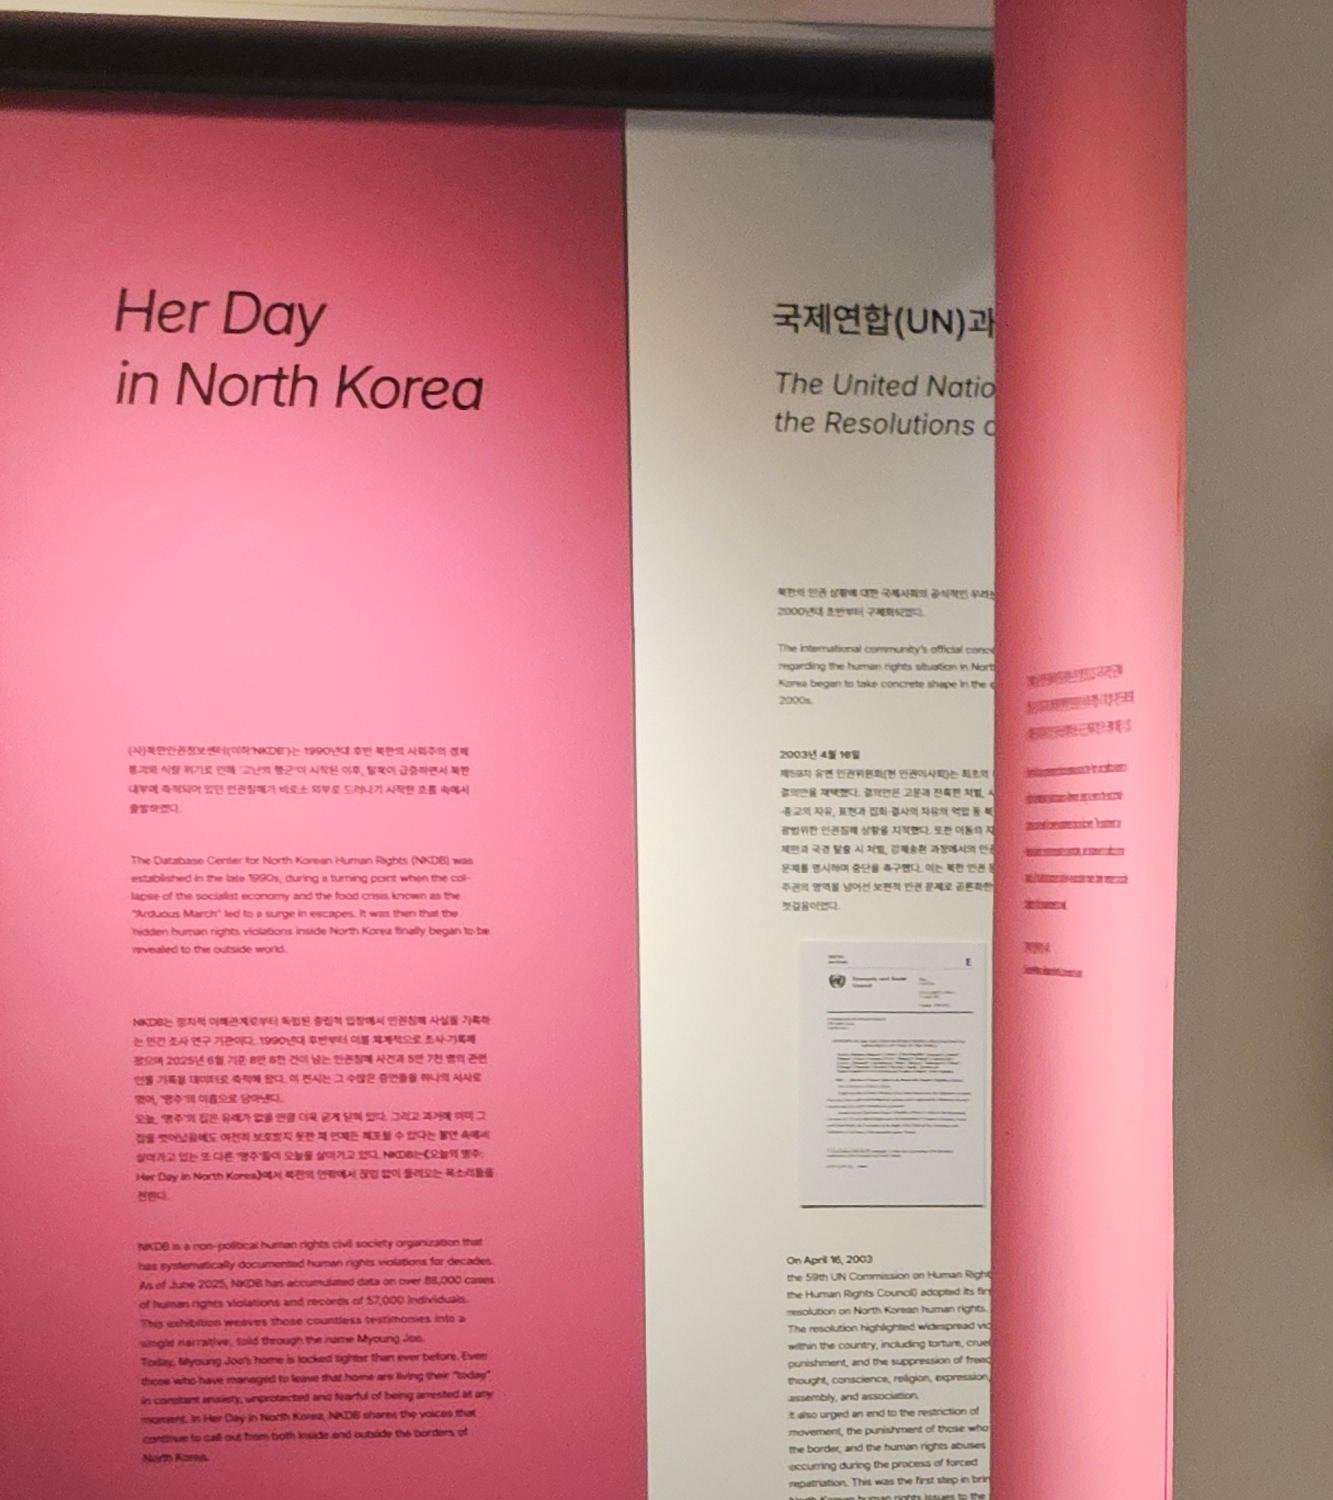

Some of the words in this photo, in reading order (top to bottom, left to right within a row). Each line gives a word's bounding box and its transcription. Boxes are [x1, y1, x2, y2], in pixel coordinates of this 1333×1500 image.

[114, 287, 211, 334] Her
[222, 290, 328, 347] Day
[772, 302, 995, 342] 국제연합(UN)과
[116, 359, 159, 405] in
[176, 362, 318, 407] North
[335, 365, 486, 410] Korea
[774, 371, 824, 395] The
[833, 373, 919, 397] United
[774, 411, 816, 433] the
[824, 411, 975, 436] Resolutions
[786, 1256, 801, 1265] On
[804, 1255, 828, 1266] April
[831, 1255, 843, 1265] 16,
[845, 1254, 874, 1264] 2003
